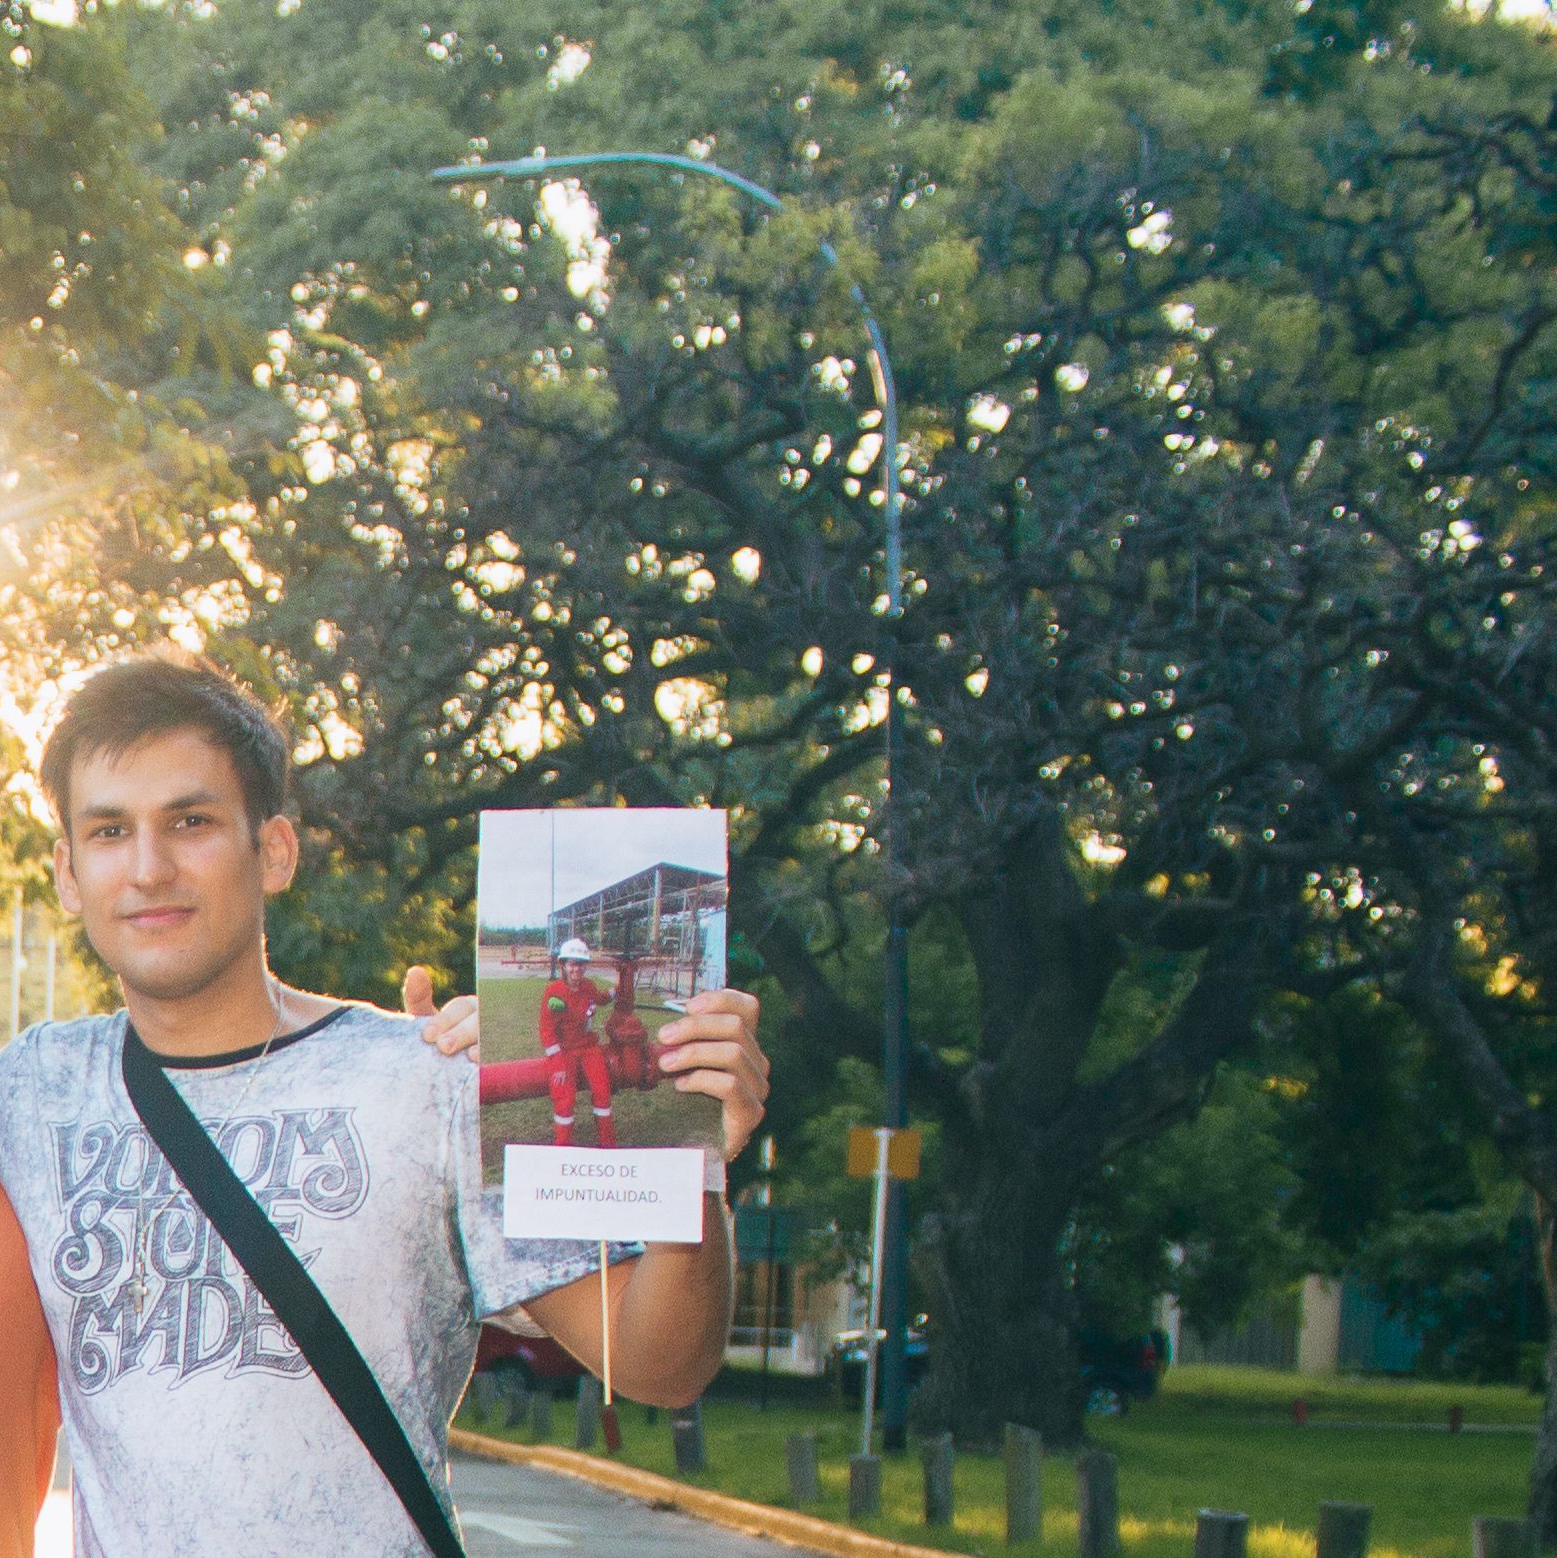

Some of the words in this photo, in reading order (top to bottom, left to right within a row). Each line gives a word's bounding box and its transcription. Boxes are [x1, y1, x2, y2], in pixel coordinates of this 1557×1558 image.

[48, 1107, 370, 1219] VOOM
[561, 1163, 615, 1178] EXCESO
[620, 1165, 638, 1178] DE
[535, 1187, 663, 1204] IMPUNTUALIDAD.
